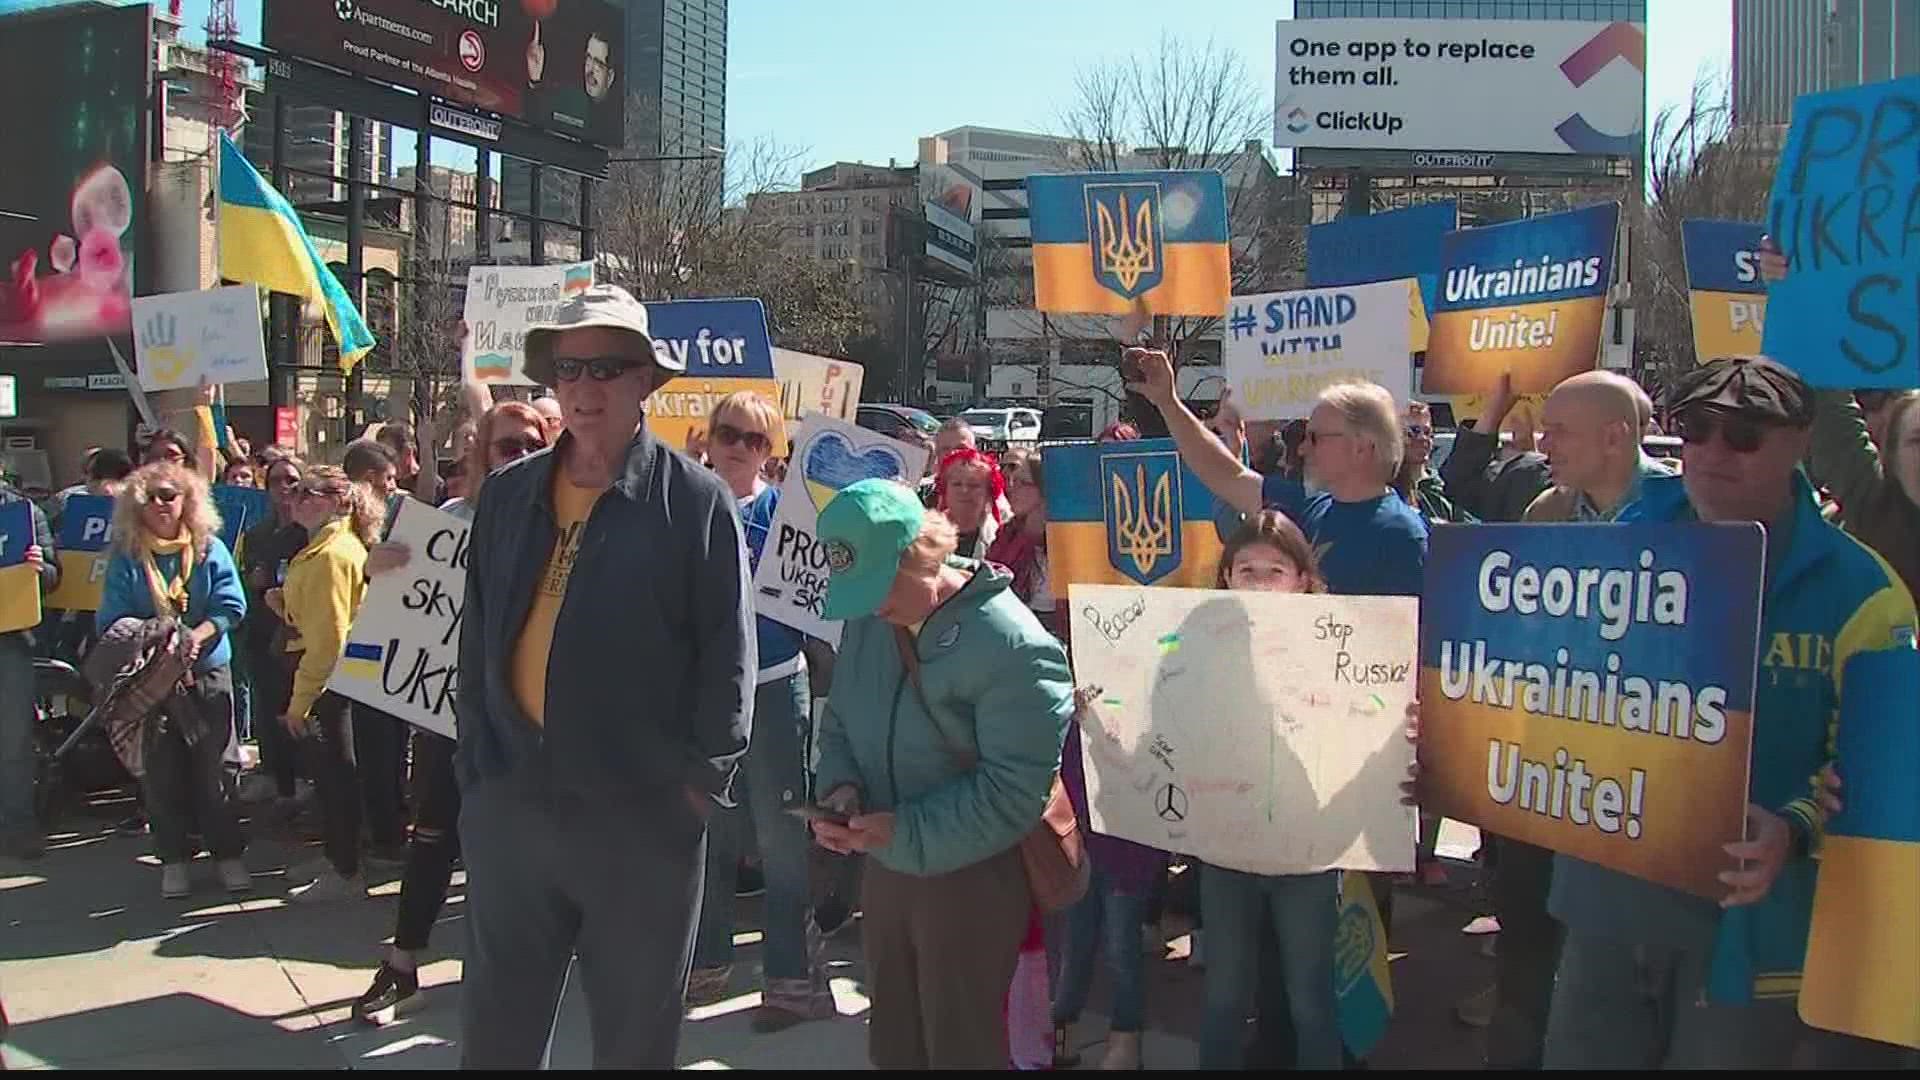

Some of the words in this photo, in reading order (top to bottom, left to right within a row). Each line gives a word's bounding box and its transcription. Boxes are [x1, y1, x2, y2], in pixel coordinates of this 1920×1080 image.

[354, 7, 433, 45] Apartments.com
[343, 40, 369, 58] Proud
[370, 49, 401, 66] Partner
[402, 59, 411, 70] of
[1289, 38, 1341, 57] One
[1347, 39, 1397, 62] app
[1404, 38, 1431, 57] to
[1438, 38, 1536, 63] replace
[1288, 66, 1356, 86] them
[1362, 67, 1399, 86] all.
[433, 111, 499, 138] OUTFRONT
[1316, 111, 1404, 135] ClickUp
[1414, 152, 1494, 168] OUTFRONT
[1445, 254, 1601, 303] Ukrainians
[1734, 249, 1761, 283] S
[697, 327, 745, 365] for
[1469, 309, 1560, 352] Unite!
[646, 382, 729, 419] krai
[402, 578, 464, 646] Sky
[1479, 549, 1689, 641] Georgia
[1314, 611, 1354, 650] Stop
[1334, 650, 1411, 688] Russia!
[1440, 637, 1728, 745] Ukrainians
[1487, 738, 1647, 840] Unite!
